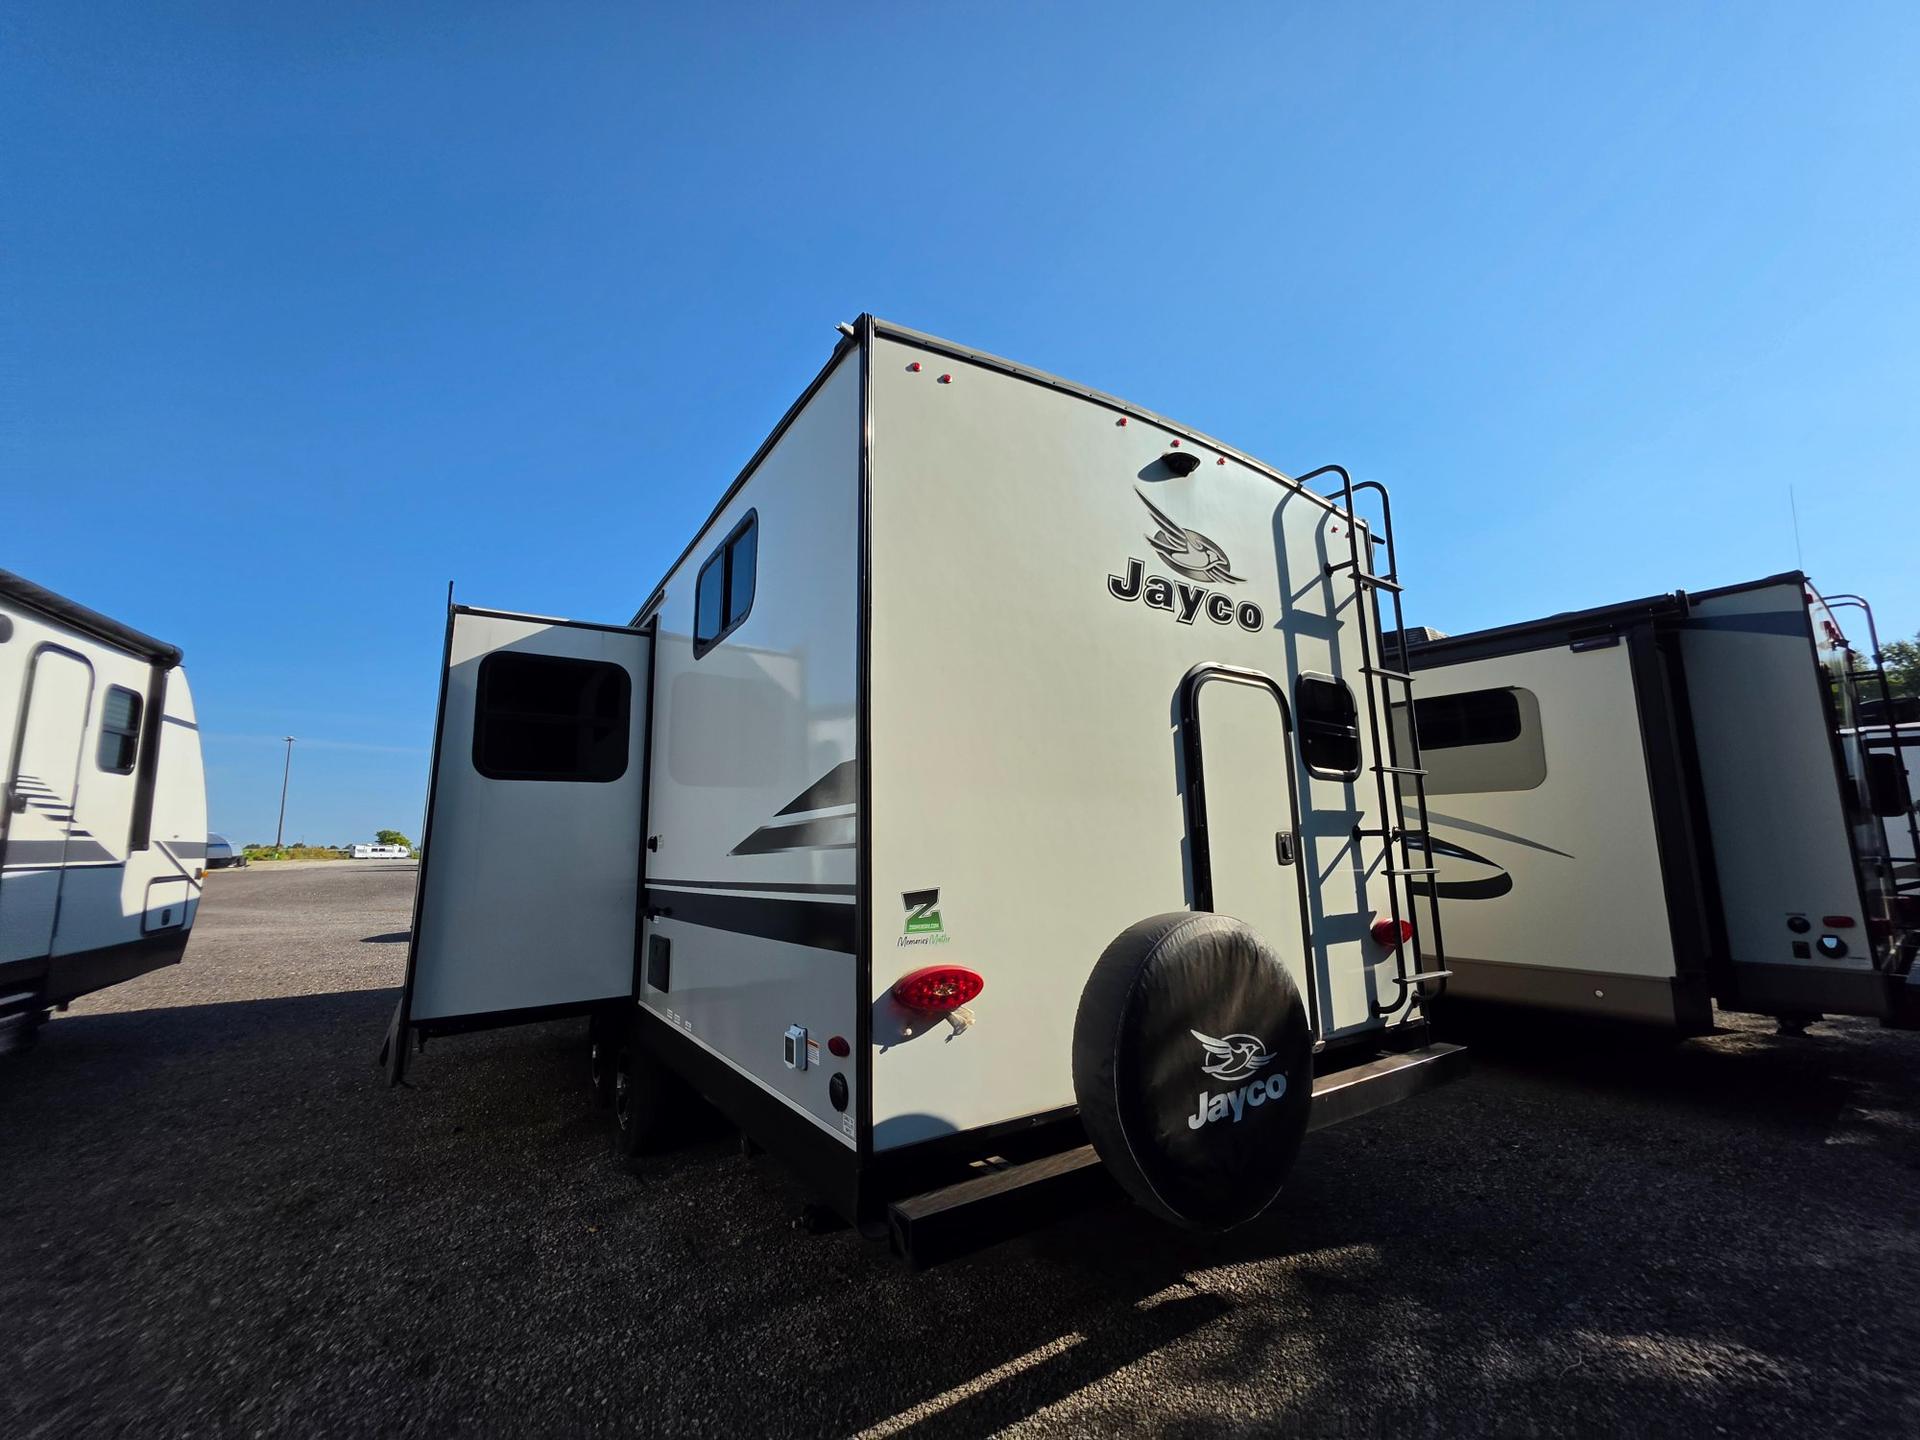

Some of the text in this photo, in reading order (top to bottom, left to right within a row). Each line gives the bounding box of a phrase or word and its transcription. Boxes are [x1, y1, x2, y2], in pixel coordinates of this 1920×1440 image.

[1107, 557, 1264, 632] Jayco
[897, 936, 929, 947] Memories
[1188, 1074, 1287, 1130] Jayco
